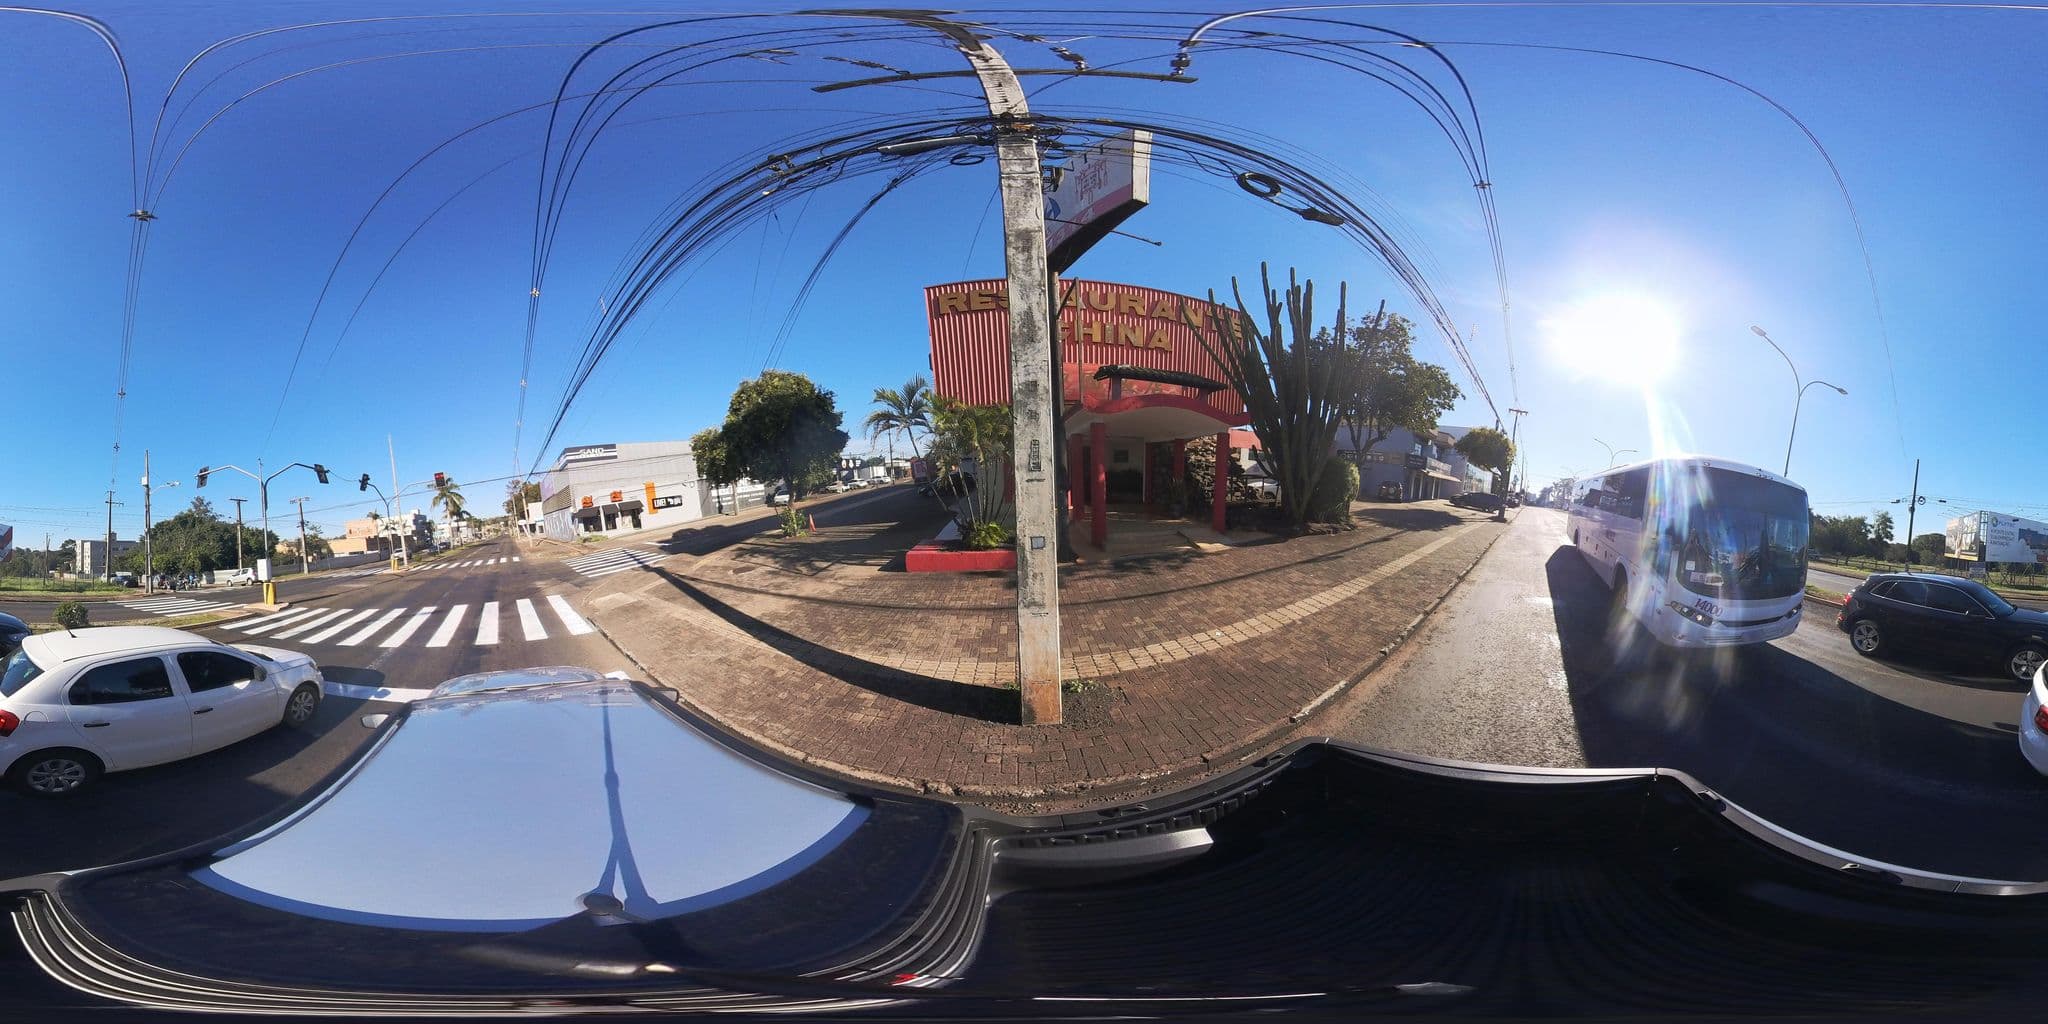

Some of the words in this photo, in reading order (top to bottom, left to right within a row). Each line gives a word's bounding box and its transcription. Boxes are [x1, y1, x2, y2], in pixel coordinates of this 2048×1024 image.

[938, 288, 1243, 338] REAURANTE
[1055, 318, 1172, 351] CHINA
[1694, 598, 1723, 617] 14000
